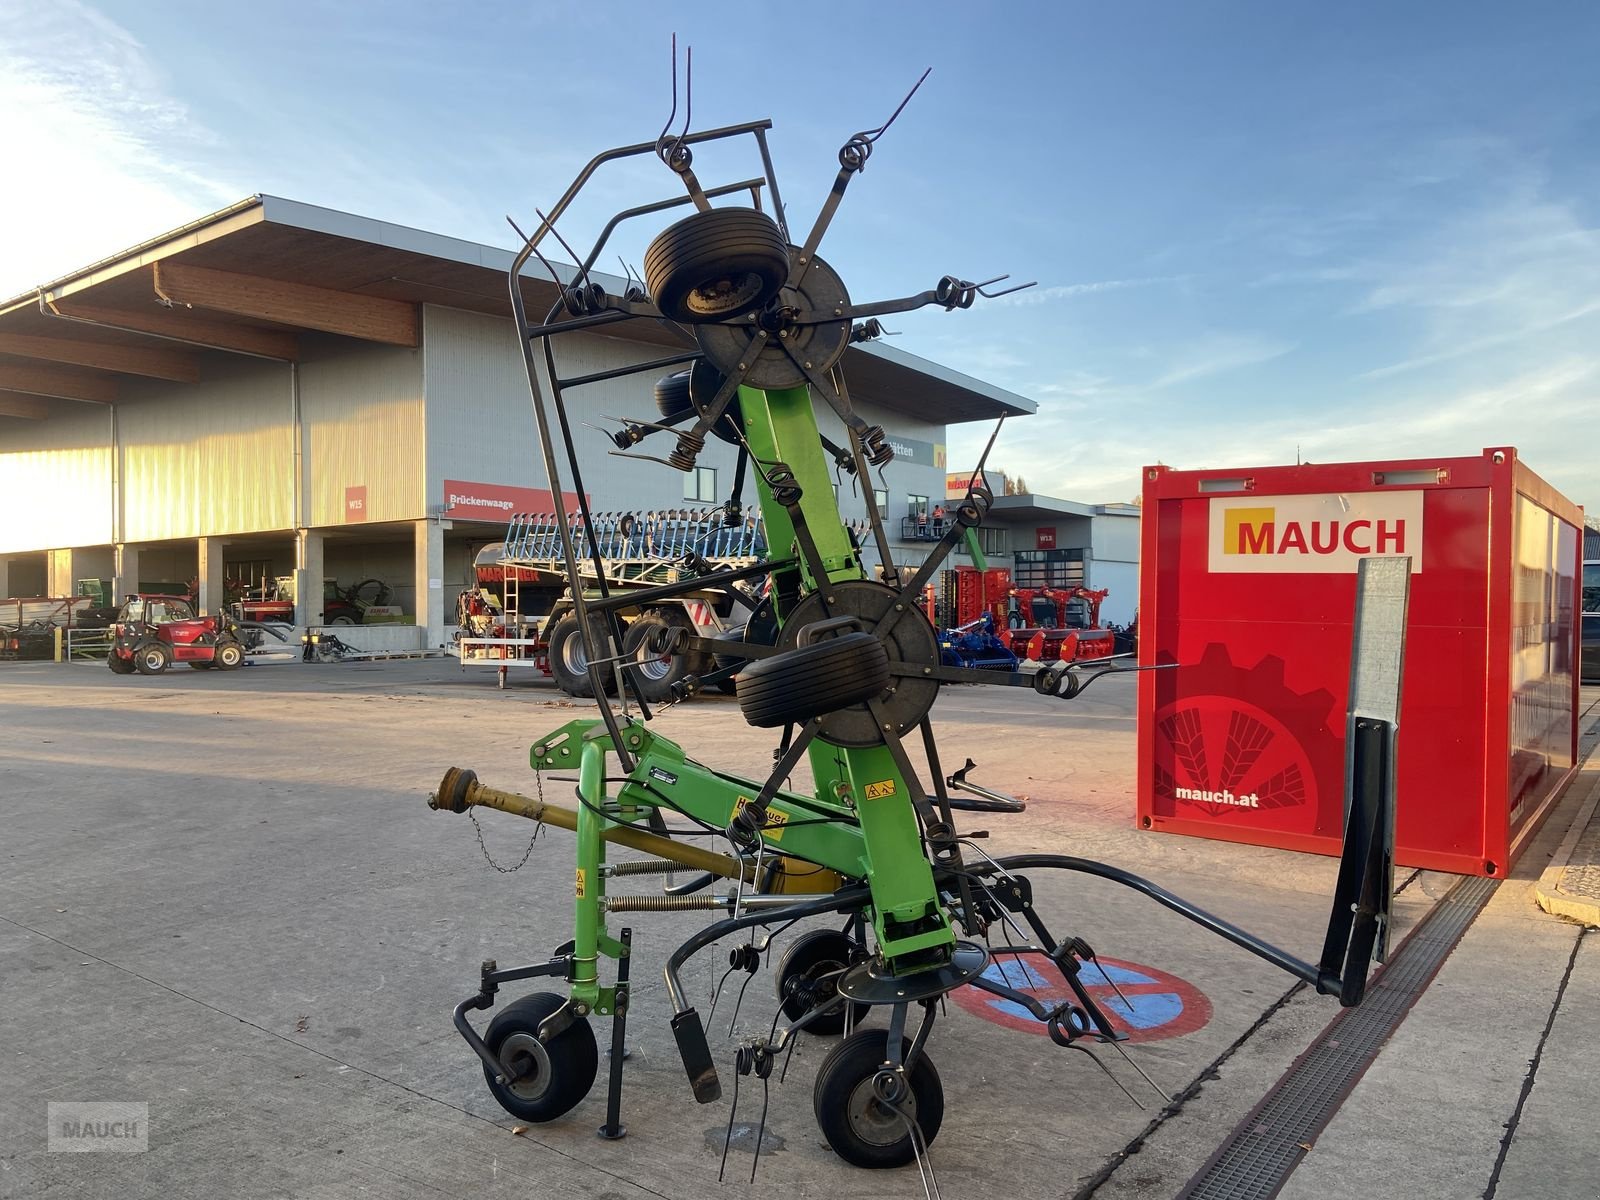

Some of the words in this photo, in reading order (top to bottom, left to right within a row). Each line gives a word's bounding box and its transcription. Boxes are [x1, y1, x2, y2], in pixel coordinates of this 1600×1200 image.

[349, 499, 363, 510] W15
[450, 494, 514, 510] Brückenwaage
[1238, 519, 1405, 555] MAUCH
[1176, 787, 1259, 807] mauch.at
